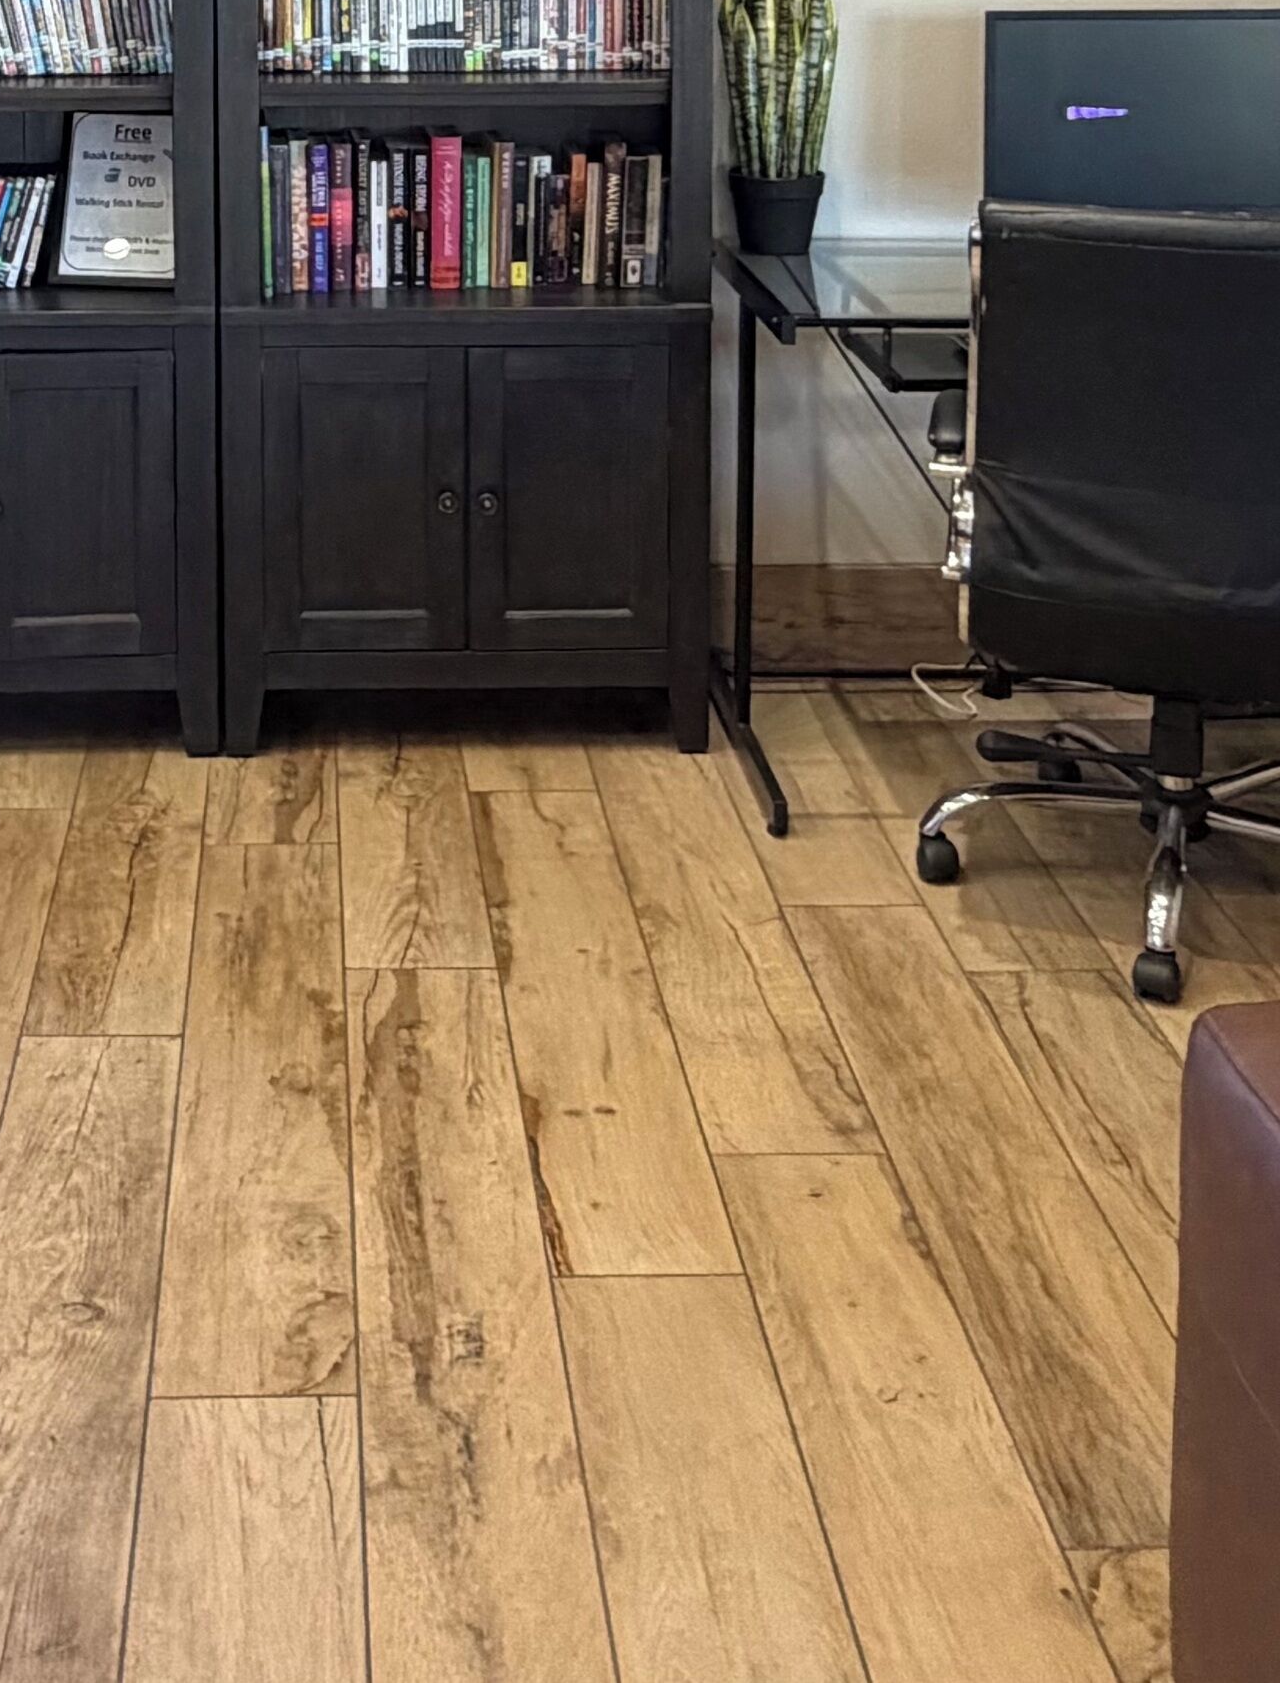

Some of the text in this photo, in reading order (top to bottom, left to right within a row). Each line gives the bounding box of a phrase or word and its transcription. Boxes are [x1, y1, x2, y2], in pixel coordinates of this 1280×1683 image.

[114, 123, 152, 142] Free
[83, 150, 156, 163] Book Exchange
[128, 176, 156, 188] DVD
[75, 198, 110, 209] Walking
[605, 173, 621, 234] MAXIMUS
